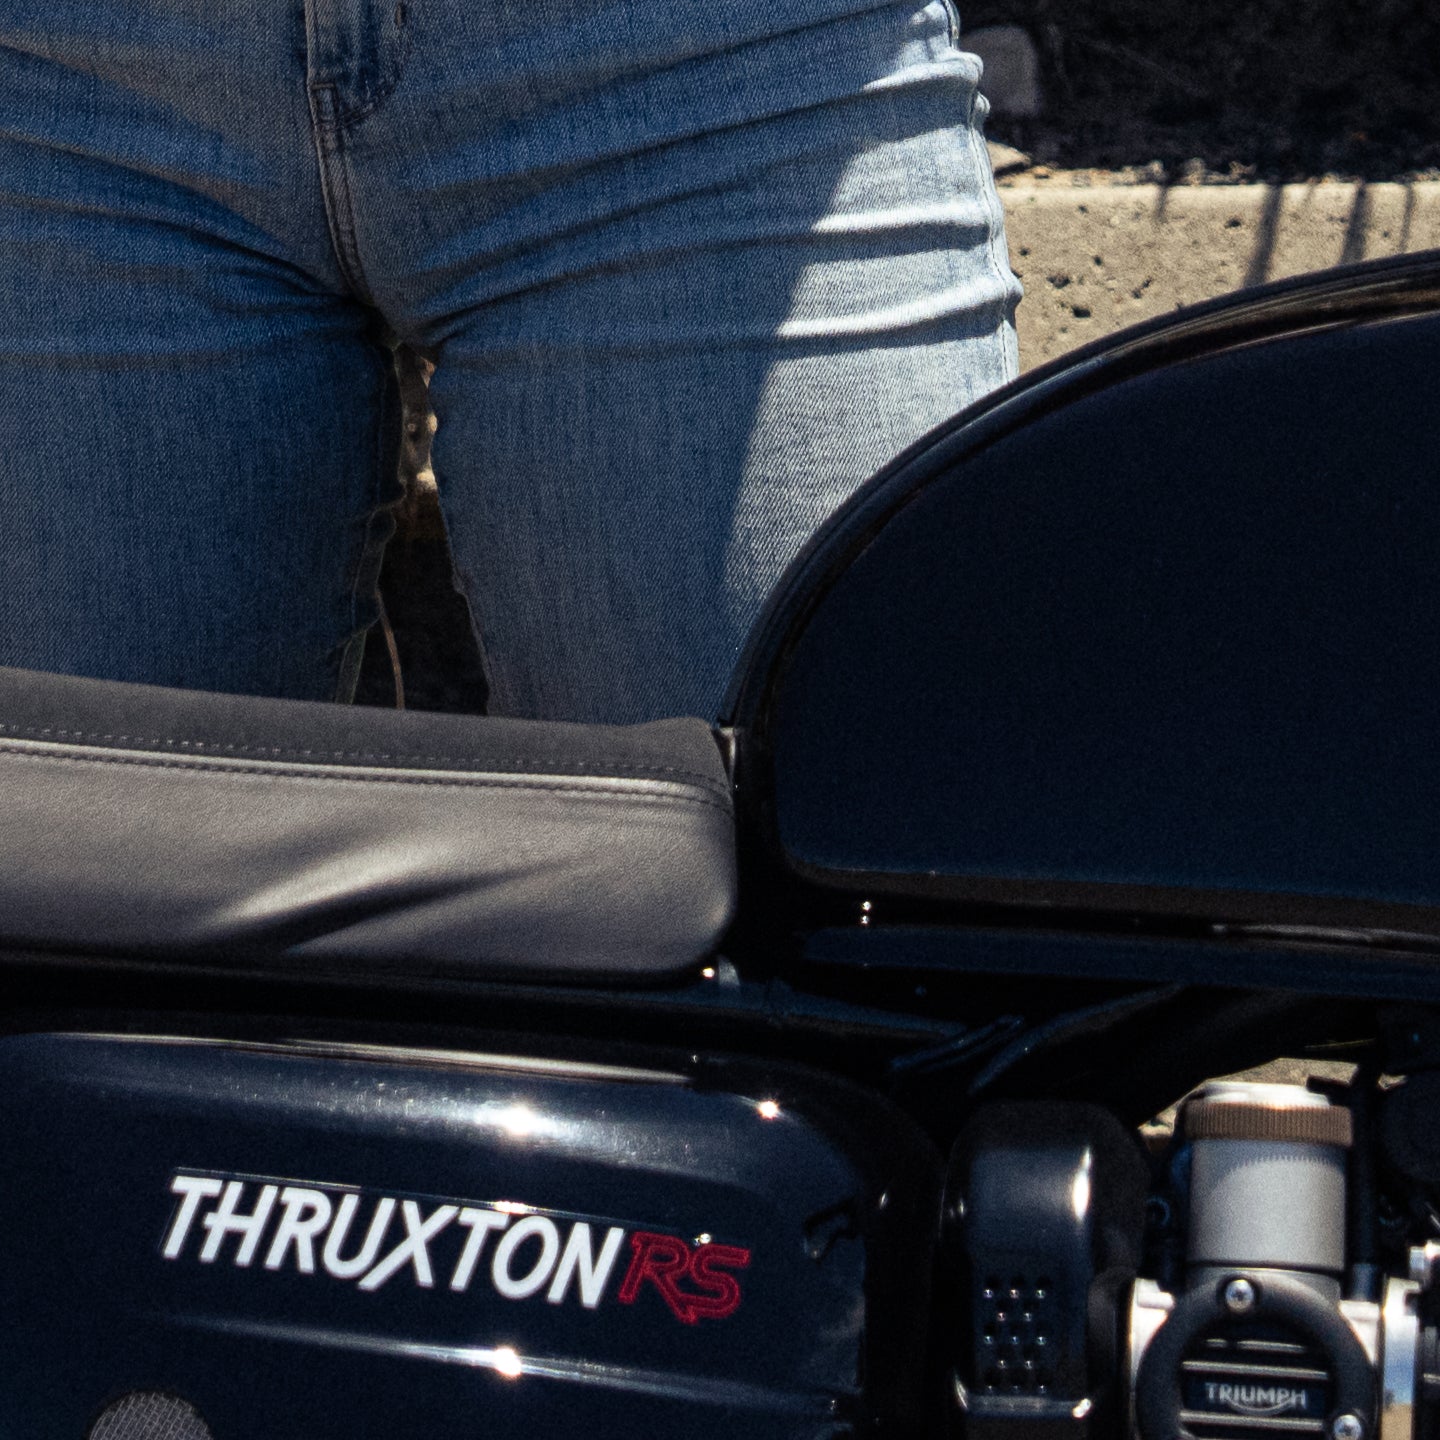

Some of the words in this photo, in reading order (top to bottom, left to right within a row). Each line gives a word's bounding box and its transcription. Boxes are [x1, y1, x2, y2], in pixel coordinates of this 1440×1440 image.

[162, 1175, 623, 1309] THRUXTON
[618, 1230, 751, 1324] RS
[1205, 1382, 1308, 1417] TRIUMPH
